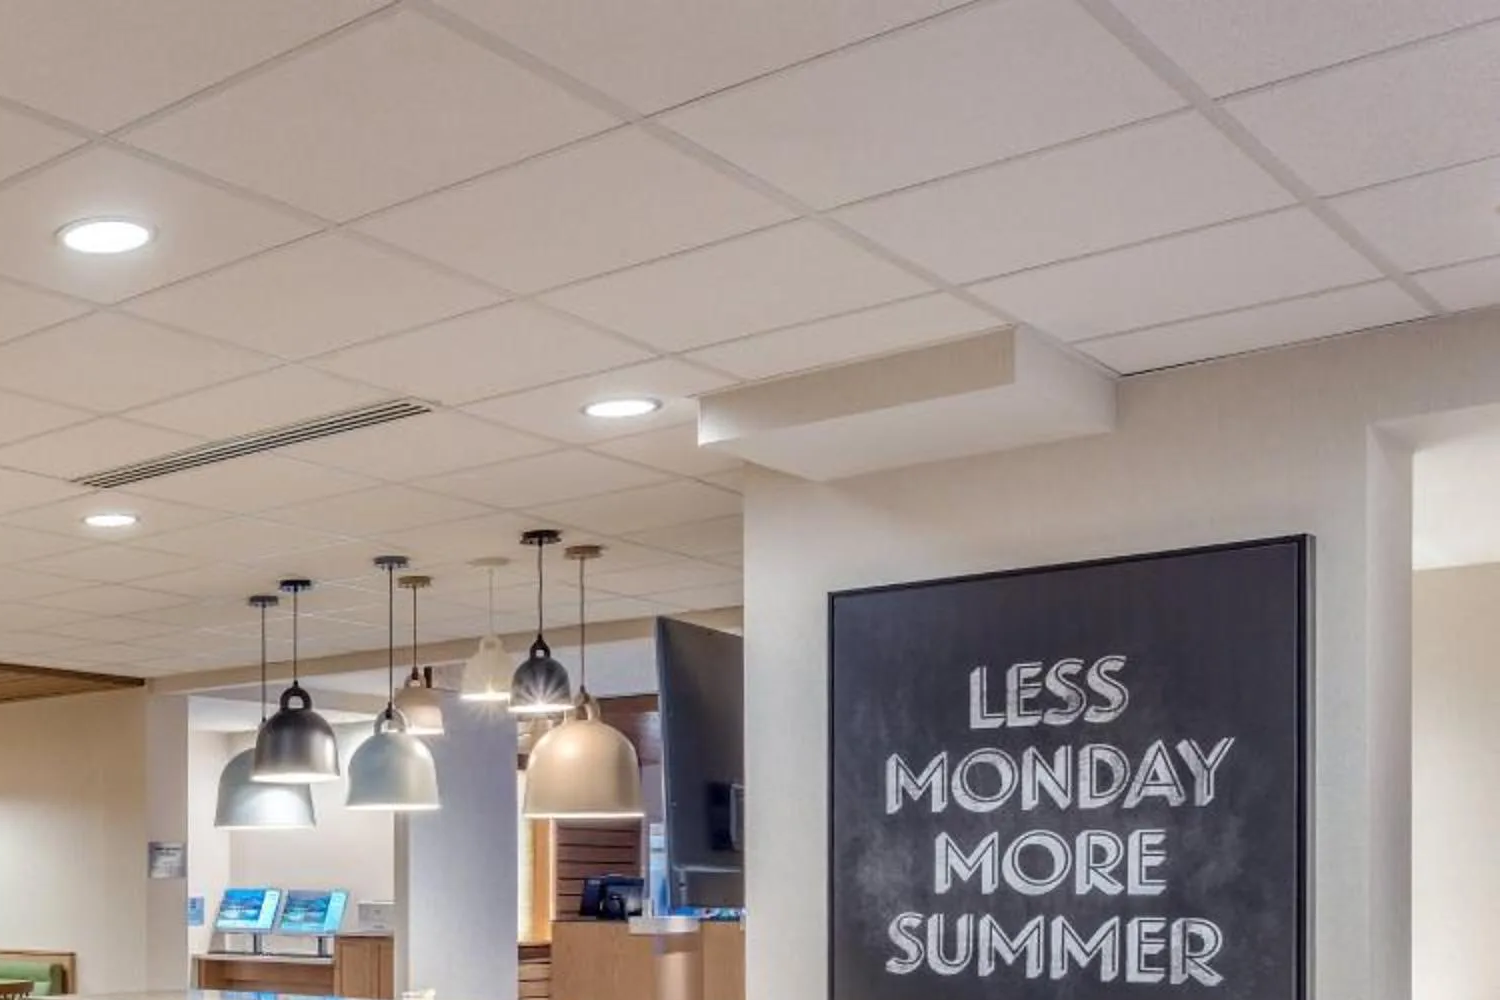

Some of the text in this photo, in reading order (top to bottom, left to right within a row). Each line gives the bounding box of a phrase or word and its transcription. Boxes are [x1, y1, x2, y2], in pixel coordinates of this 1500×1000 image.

[969, 655, 1129, 729] LESS
[885, 737, 1235, 814] MONDAY
[934, 829, 1167, 895] MORE
[885, 912, 1224, 987] SUMMER
